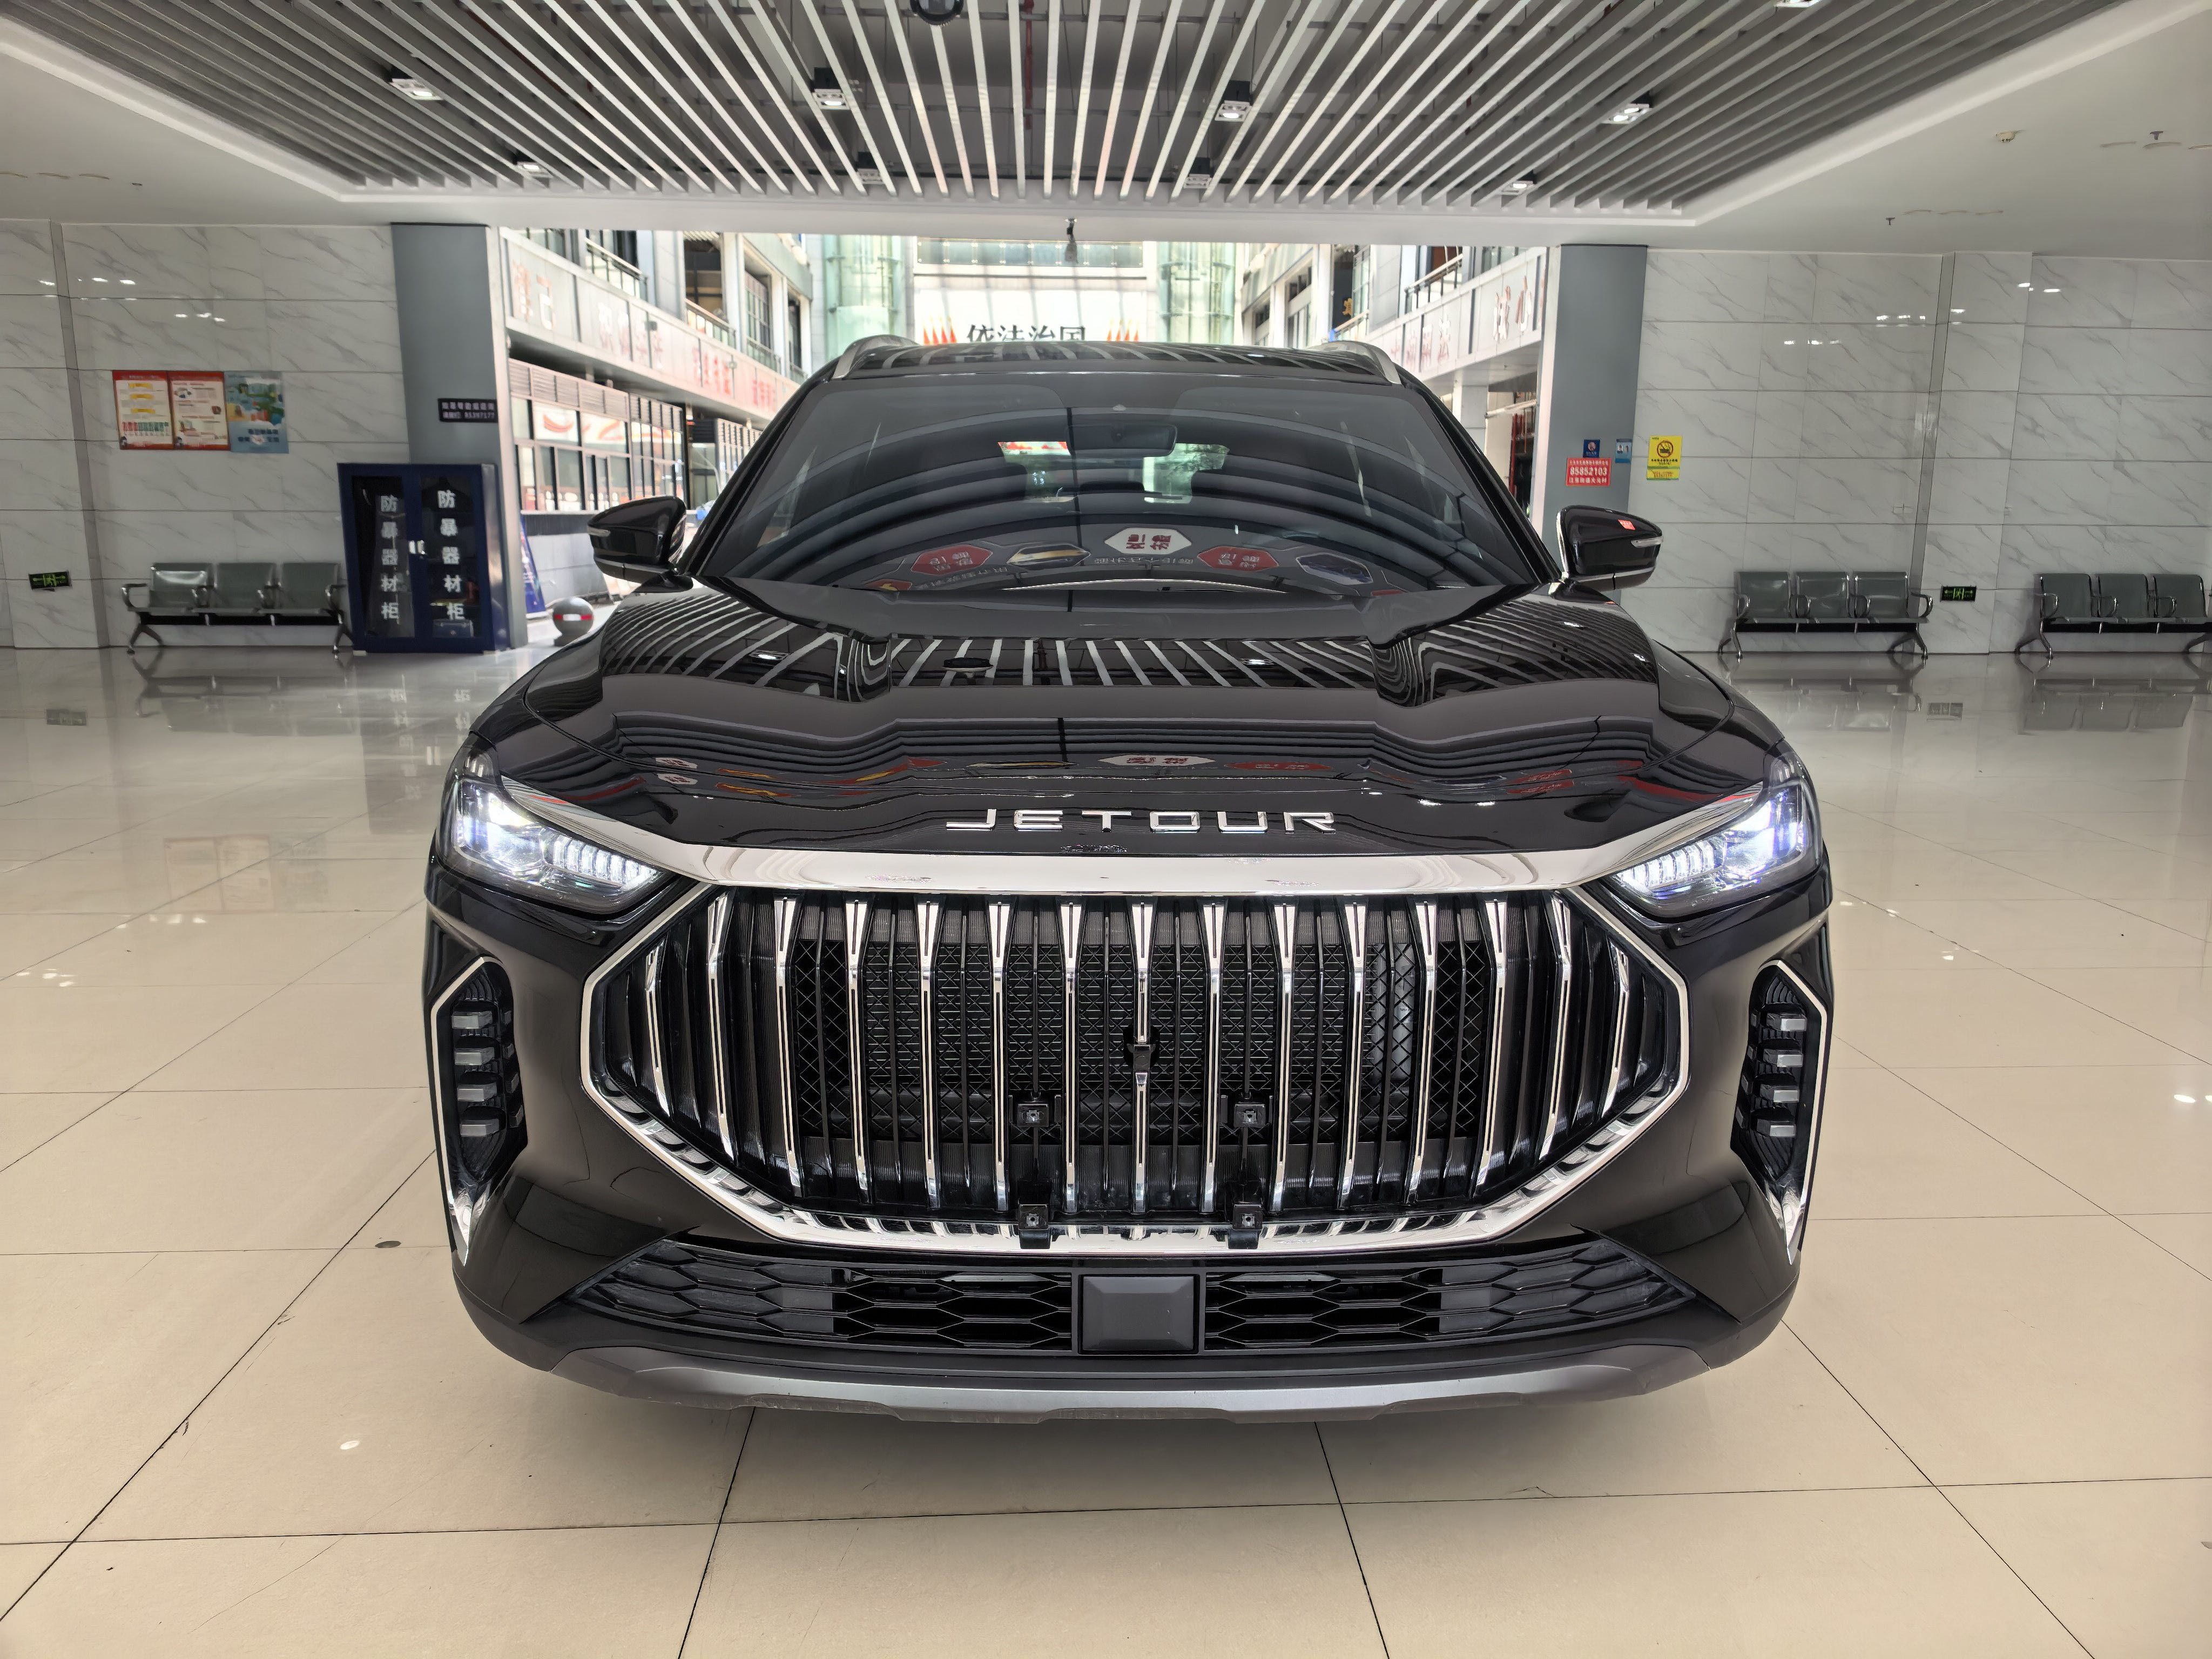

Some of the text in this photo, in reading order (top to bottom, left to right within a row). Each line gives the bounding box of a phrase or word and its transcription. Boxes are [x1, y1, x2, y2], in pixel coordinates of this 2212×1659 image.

[966, 323, 1086, 341] 依法治国
[437, 489, 466, 621] 防暴器材柜
[945, 808, 1337, 834] JETOUR
